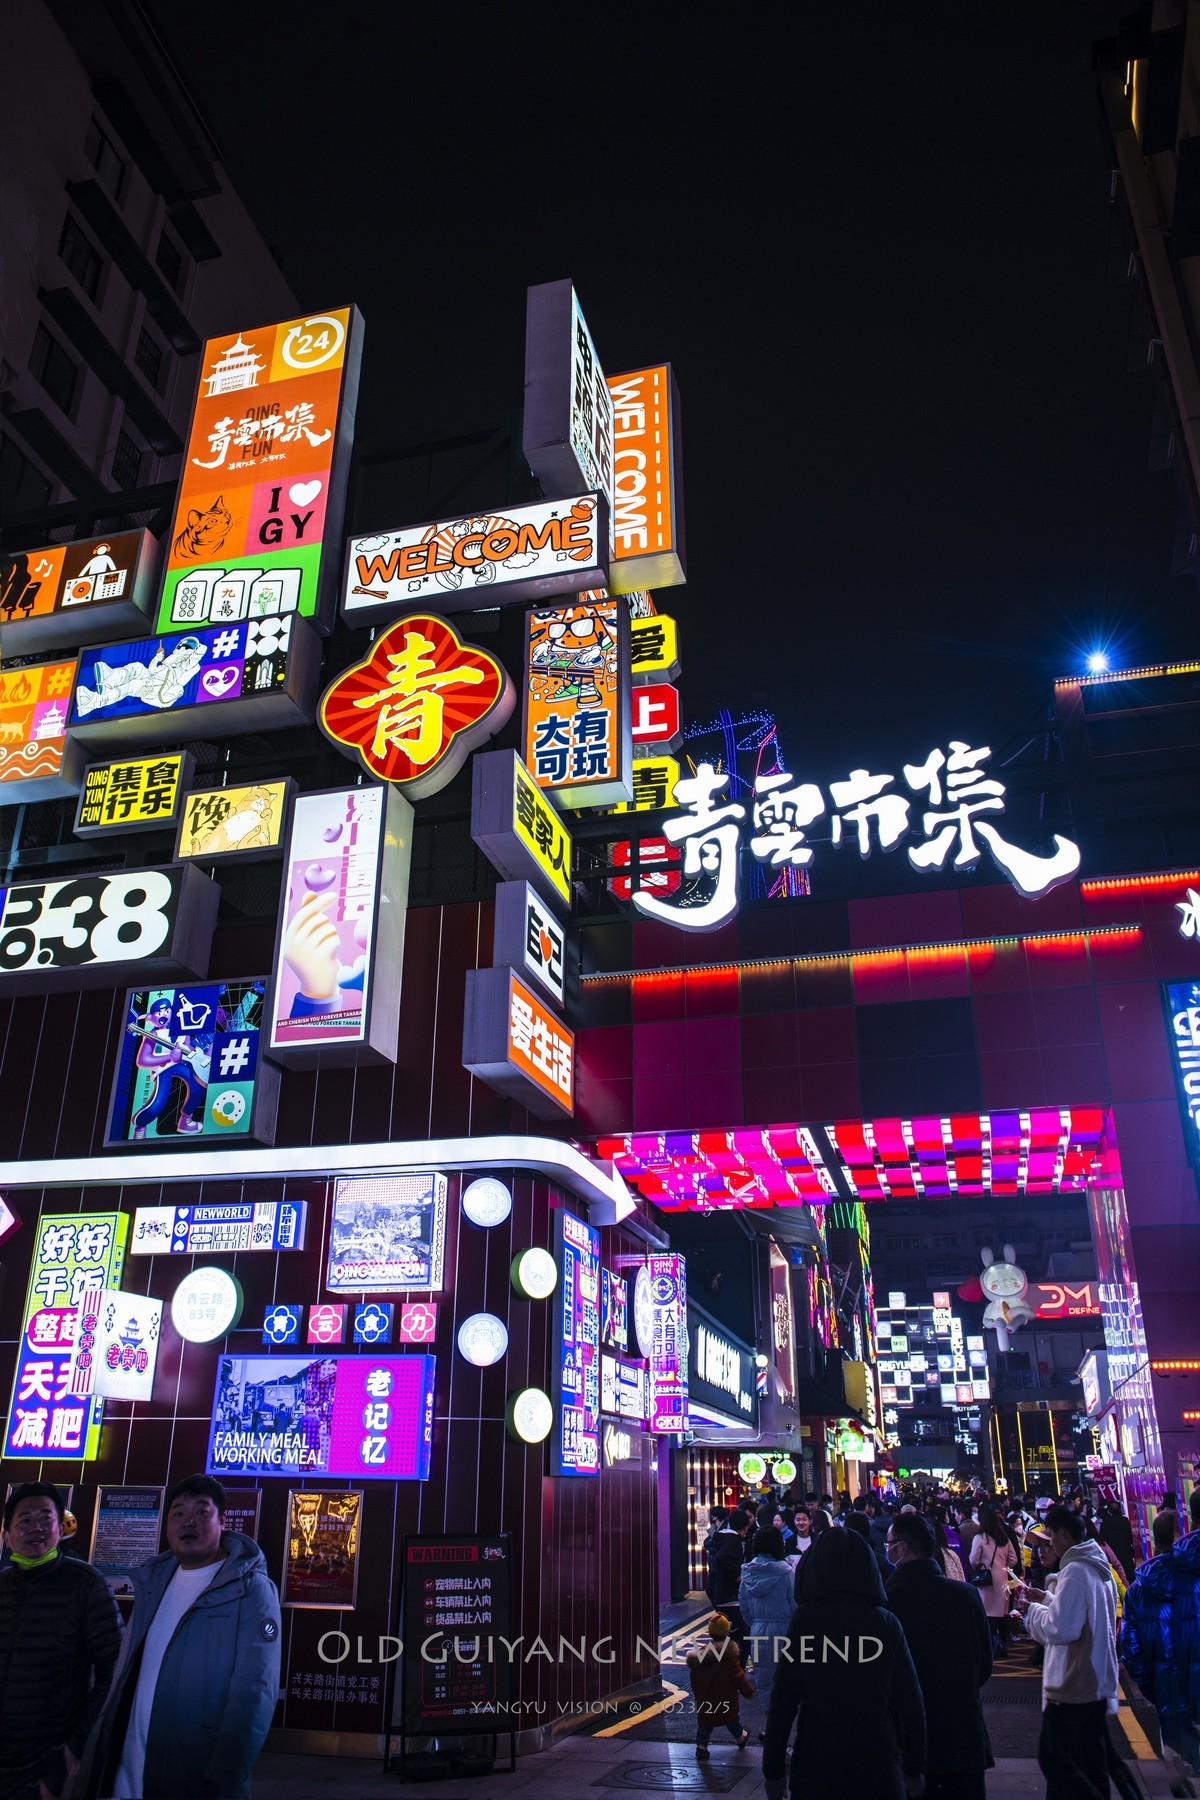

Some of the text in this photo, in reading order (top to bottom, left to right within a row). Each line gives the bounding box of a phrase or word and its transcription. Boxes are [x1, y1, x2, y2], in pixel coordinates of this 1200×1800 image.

[296, 330, 330, 355] 24
[268, 486, 283, 513] I
[258, 510, 315, 545] GY
[356, 516, 593, 586] WELCOME
[353, 632, 485, 766] 青
[535, 708, 611, 749] 大有
[632, 696, 668, 735] 上
[86, 769, 109, 786] QING
[110, 761, 178, 791] 集食
[534, 748, 610, 782] 可玩
[85, 788, 104, 803] YUN
[105, 788, 173, 820] 行乐
[80, 805, 101, 823] FUN
[188, 795, 231, 837] 馋
[515, 770, 571, 887] 爱家人
[288, 1017, 310, 1026] CHERISH
[321, 1013, 343, 1021] FOREVER
[511, 992, 572, 1096] 爱生活
[39, 1223, 111, 1263] 好好
[653, 1259, 674, 1269] QING
[35, 1266, 106, 1308] 干饭
[187, 1292, 223, 1305] 青云路
[189, 1308, 216, 1320] 83号
[317, 1315, 334, 1331] 云
[412, 1314, 426, 1331] 力
[1068, 1306, 1101, 1315] DEFINE
[76, 1313, 98, 1371] 老贵阳
[664, 1308, 676, 1370] 大有可玩
[107, 1345, 148, 1374] 老贵阳
[12, 1407, 84, 1449] 减肥
[362, 1369, 393, 1465] 老记忆
[215, 1432, 310, 1449] FAMILY MEAL
[213, 1447, 325, 1465] WORKING MEAL
[411, 1546, 473, 1561] WARNING
[435, 1577, 491, 1591] 宠物禁止入内
[435, 1595, 492, 1609] 车辆禁止入内
[435, 1611, 492, 1626] 货品禁止入内
[291, 1672, 381, 1690] 兴关路街道党工委
[290, 1687, 379, 1705] 兴关路街道办事处
